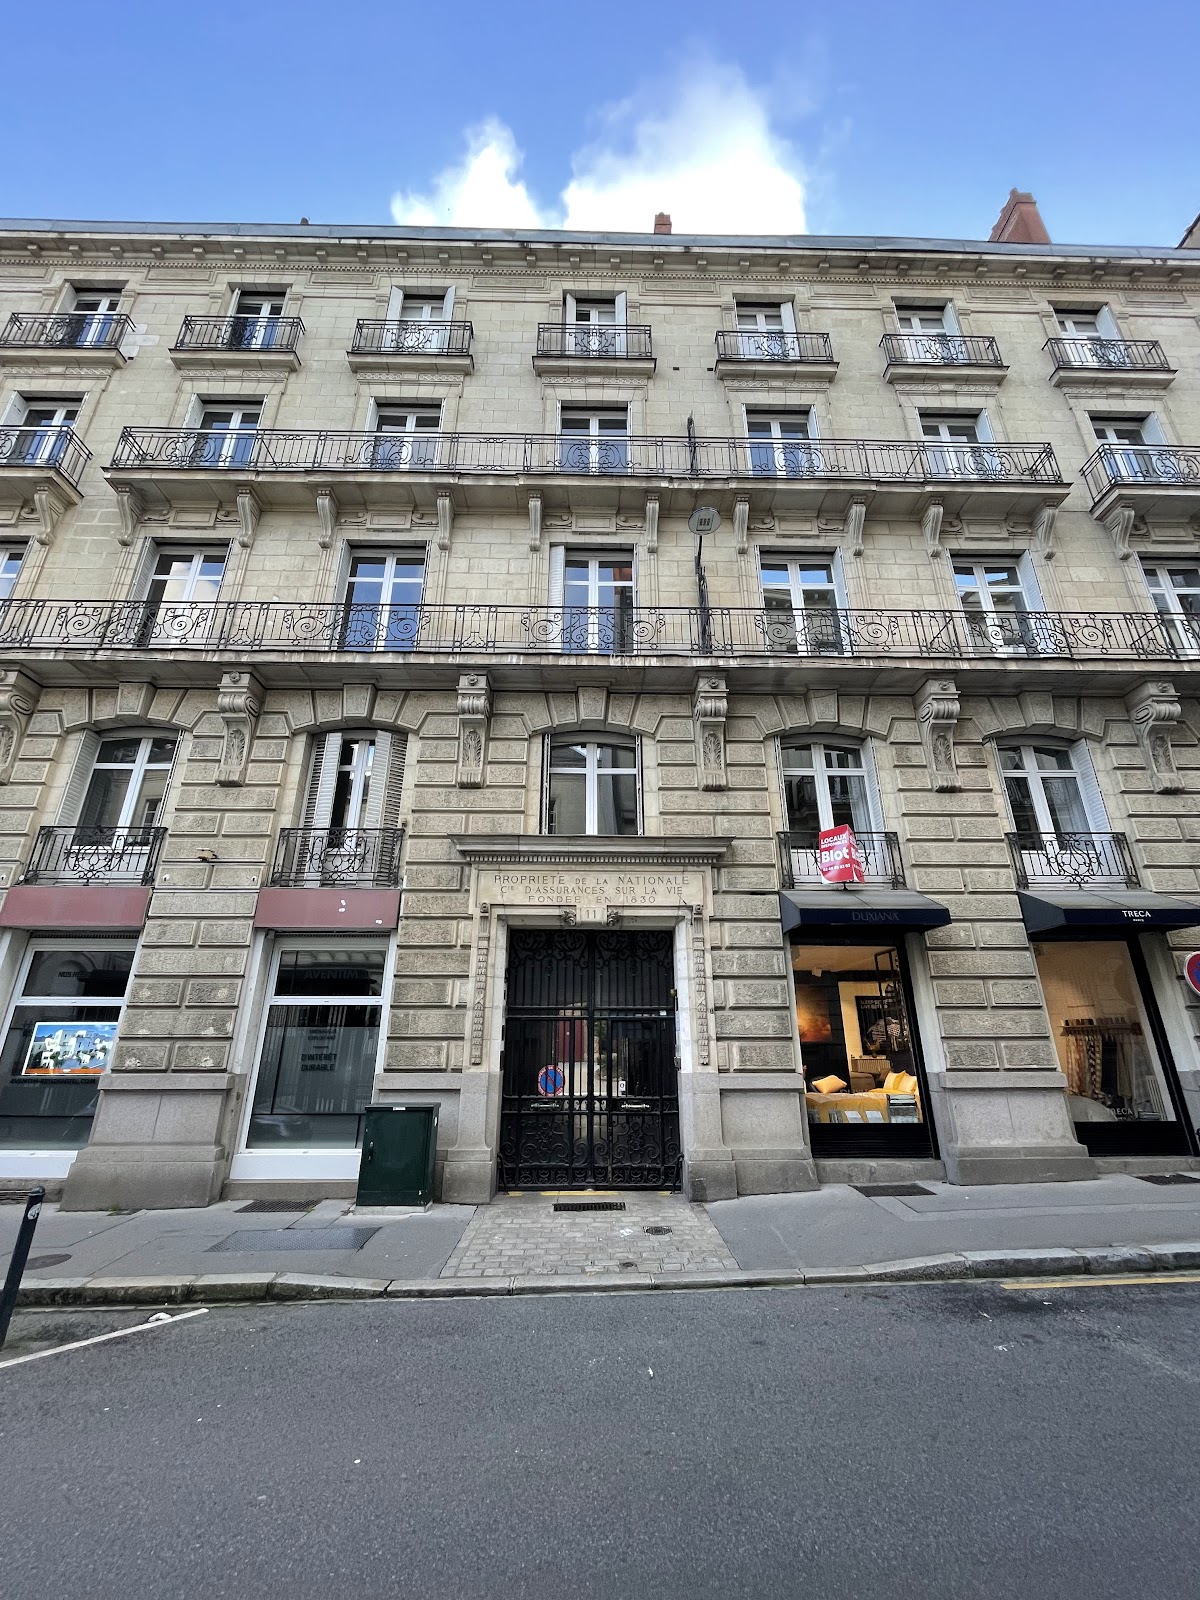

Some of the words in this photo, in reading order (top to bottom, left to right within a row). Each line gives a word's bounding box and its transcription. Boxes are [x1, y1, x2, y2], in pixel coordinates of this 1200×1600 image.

[820, 833, 847, 844] LOCAUX
[821, 846, 850, 863] Blot
[494, 875, 565, 885] PROPRIETE
[575, 877, 587, 885] DE
[618, 876, 690, 885] NATIONALE
[615, 886, 636, 895] SUR
[644, 886, 658, 895] LA
[666, 886, 684, 895] VIE
[528, 895, 582, 903] FONDEE
[625, 896, 656, 904] 1830
[585, 909, 597, 919] 11
[852, 912, 900, 921] DUXIANA
[1121, 910, 1152, 918] TRECA
[305, 970, 359, 979] AVENTIM
[301, 1052, 337, 1061] D'INTÉRÊT
[301, 1064, 335, 1072] DURABLE
